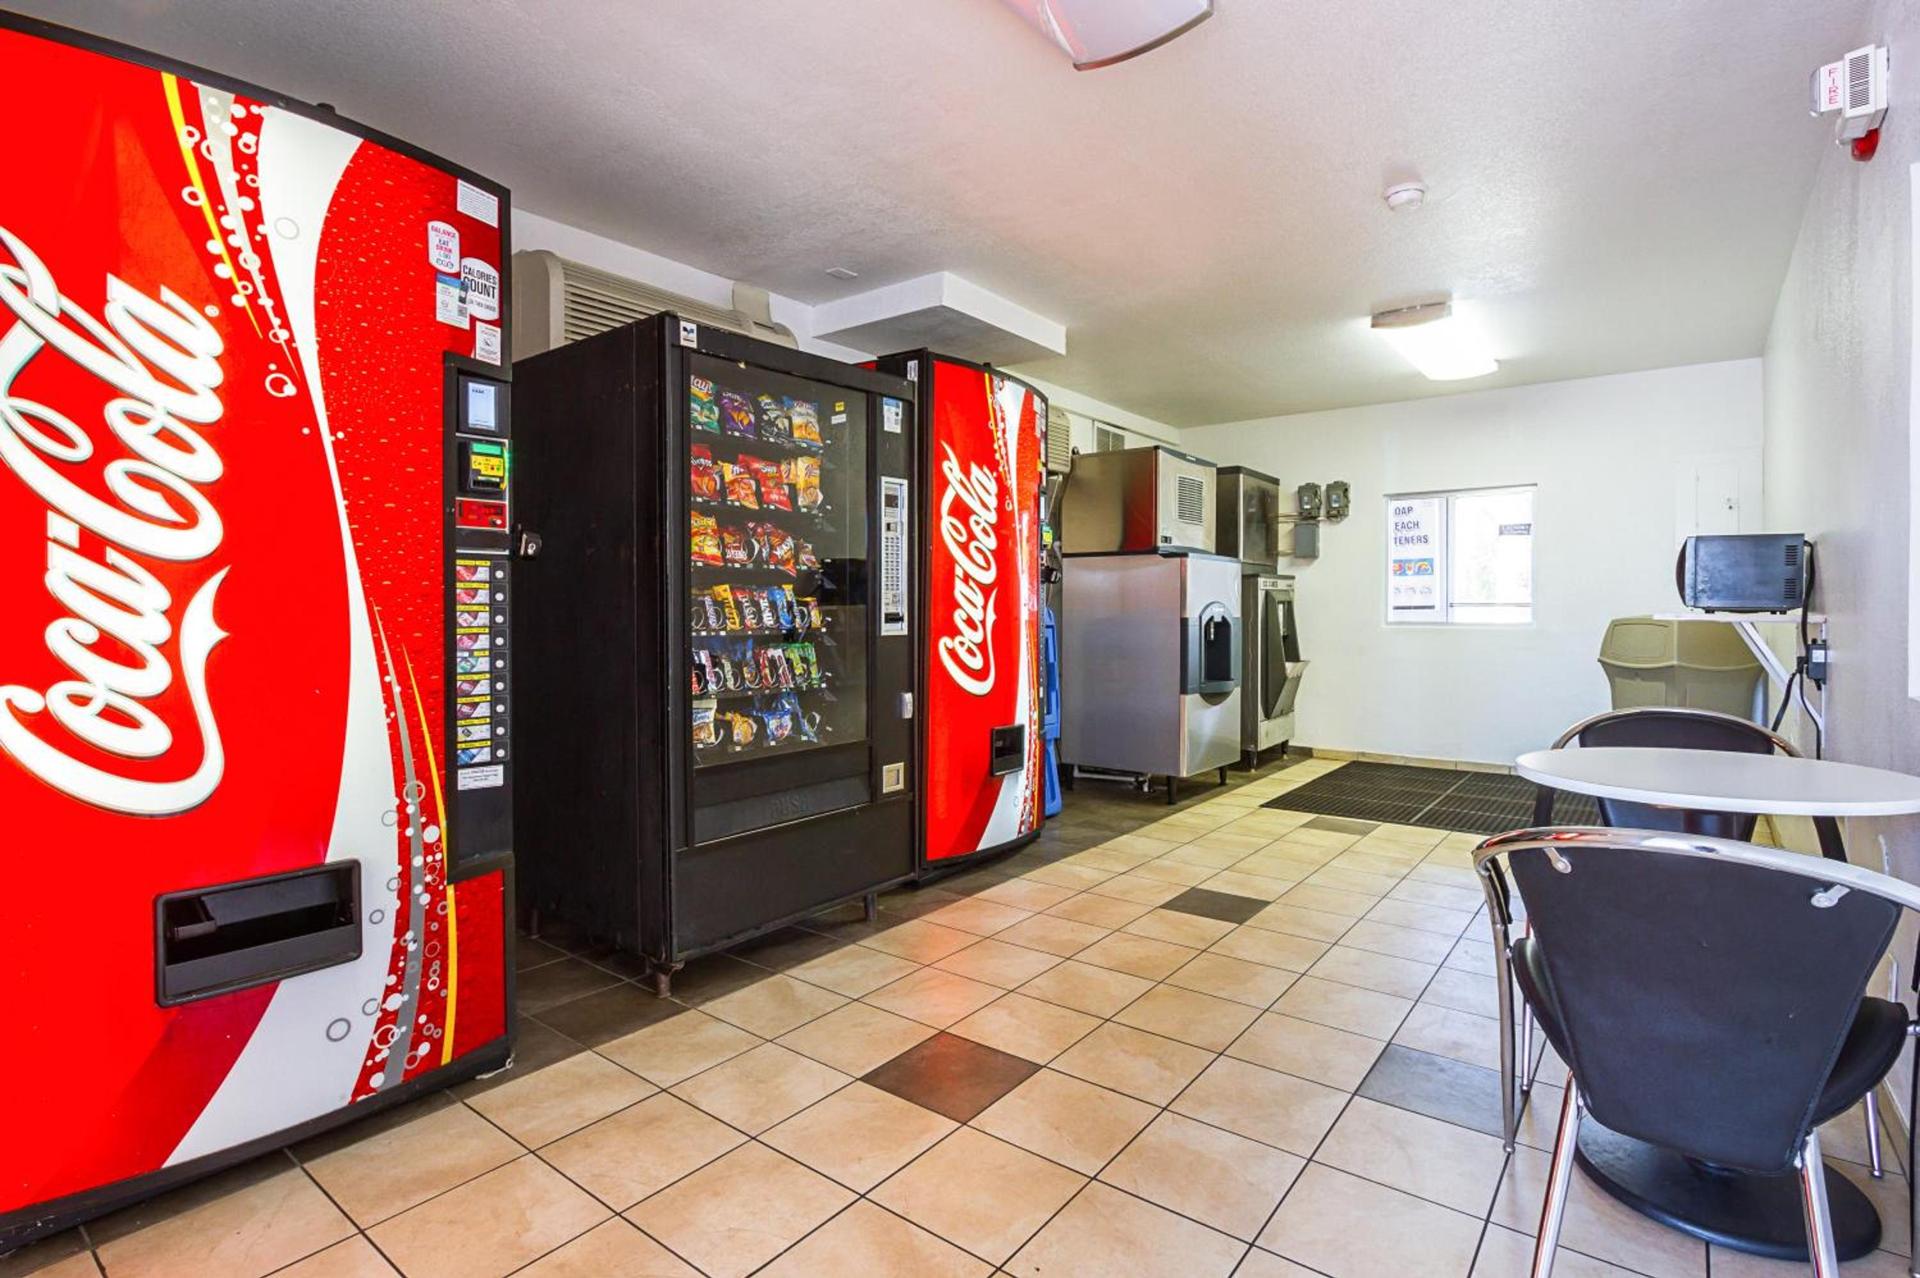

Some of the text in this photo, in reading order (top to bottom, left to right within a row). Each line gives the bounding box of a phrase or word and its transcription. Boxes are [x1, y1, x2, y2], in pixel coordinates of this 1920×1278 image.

[1828, 67, 1839, 105] FIRE
[463, 264, 497, 285] CALORIES
[1394, 520, 1420, 531] EACH
[938, 439, 999, 697] Coca-Cola
